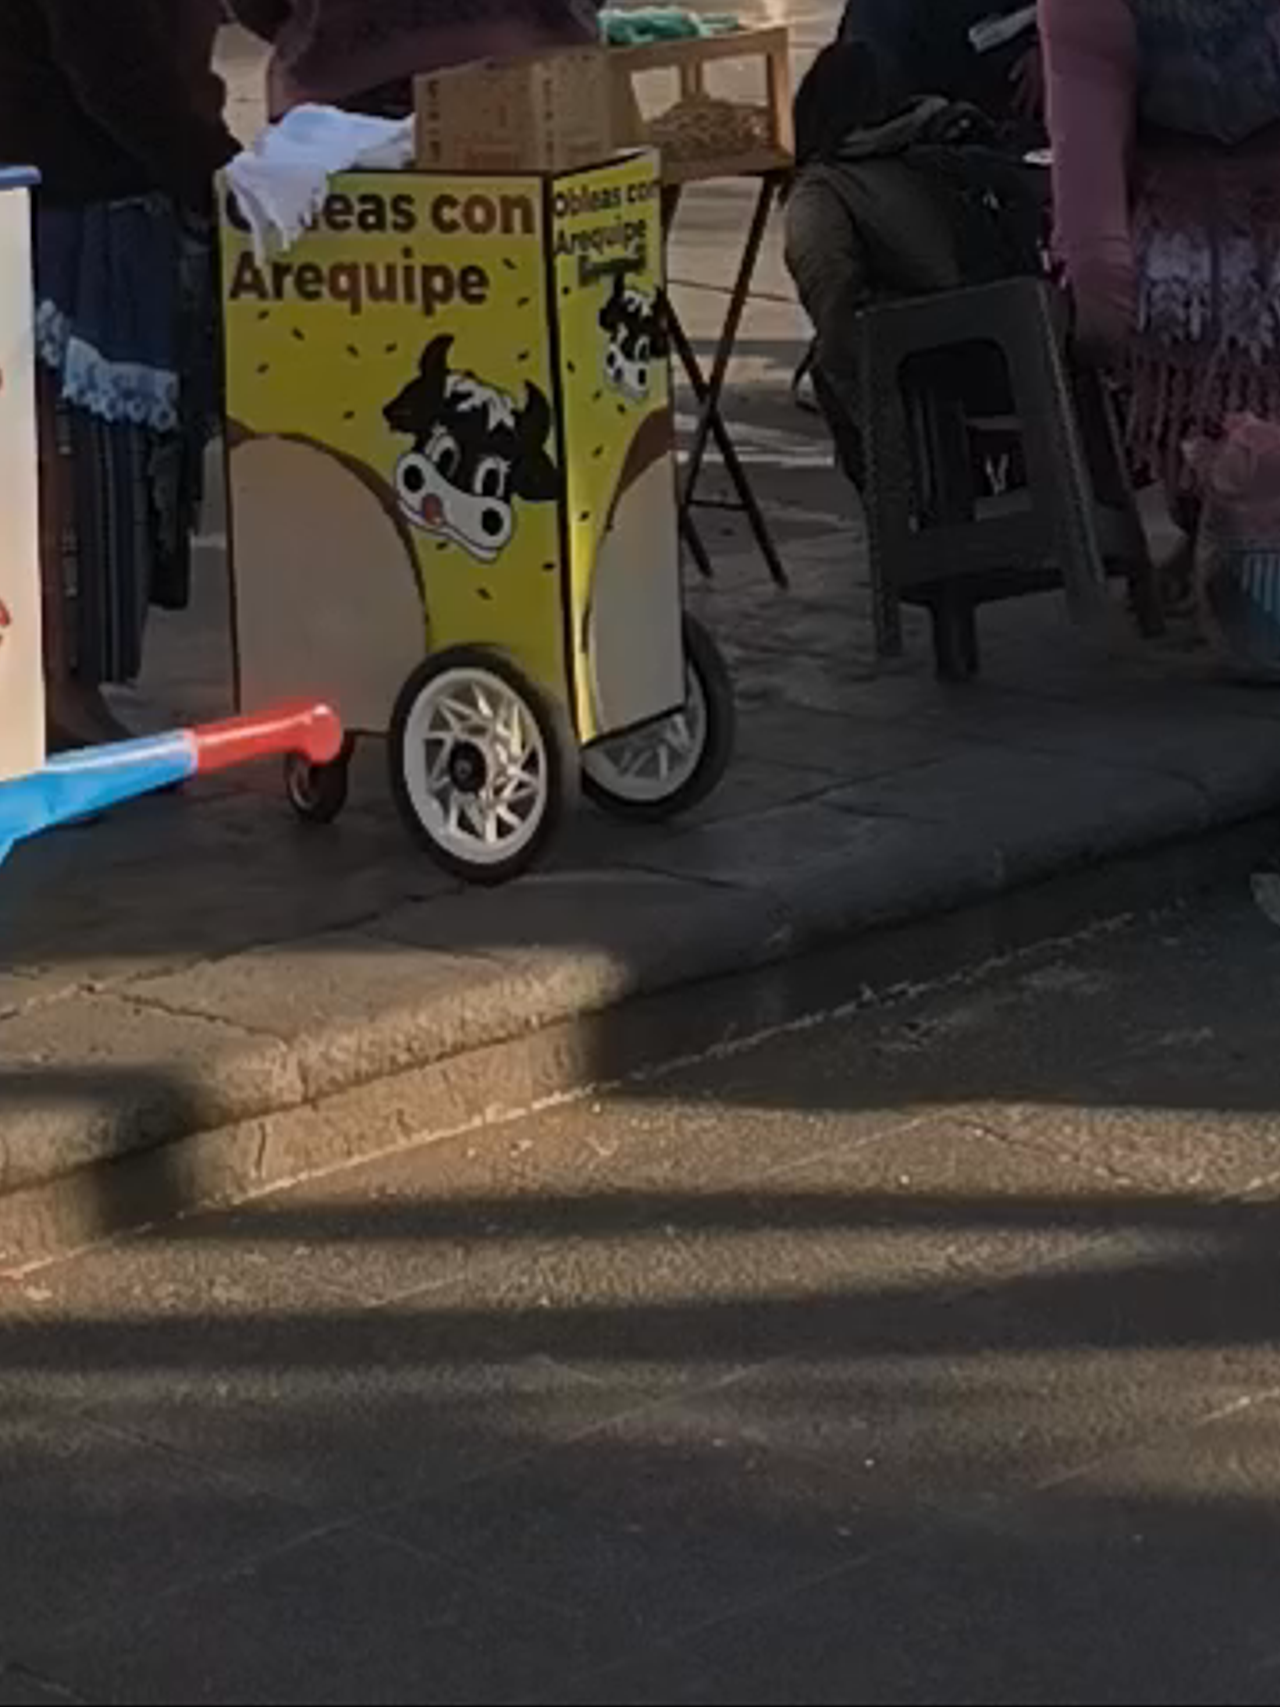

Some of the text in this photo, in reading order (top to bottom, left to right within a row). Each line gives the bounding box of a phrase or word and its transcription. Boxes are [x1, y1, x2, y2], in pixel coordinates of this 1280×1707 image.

[225, 189, 536, 234] eas con
[553, 184, 623, 219] Obleas
[553, 218, 647, 256] Arequipe
[228, 246, 491, 317] Arequipe
